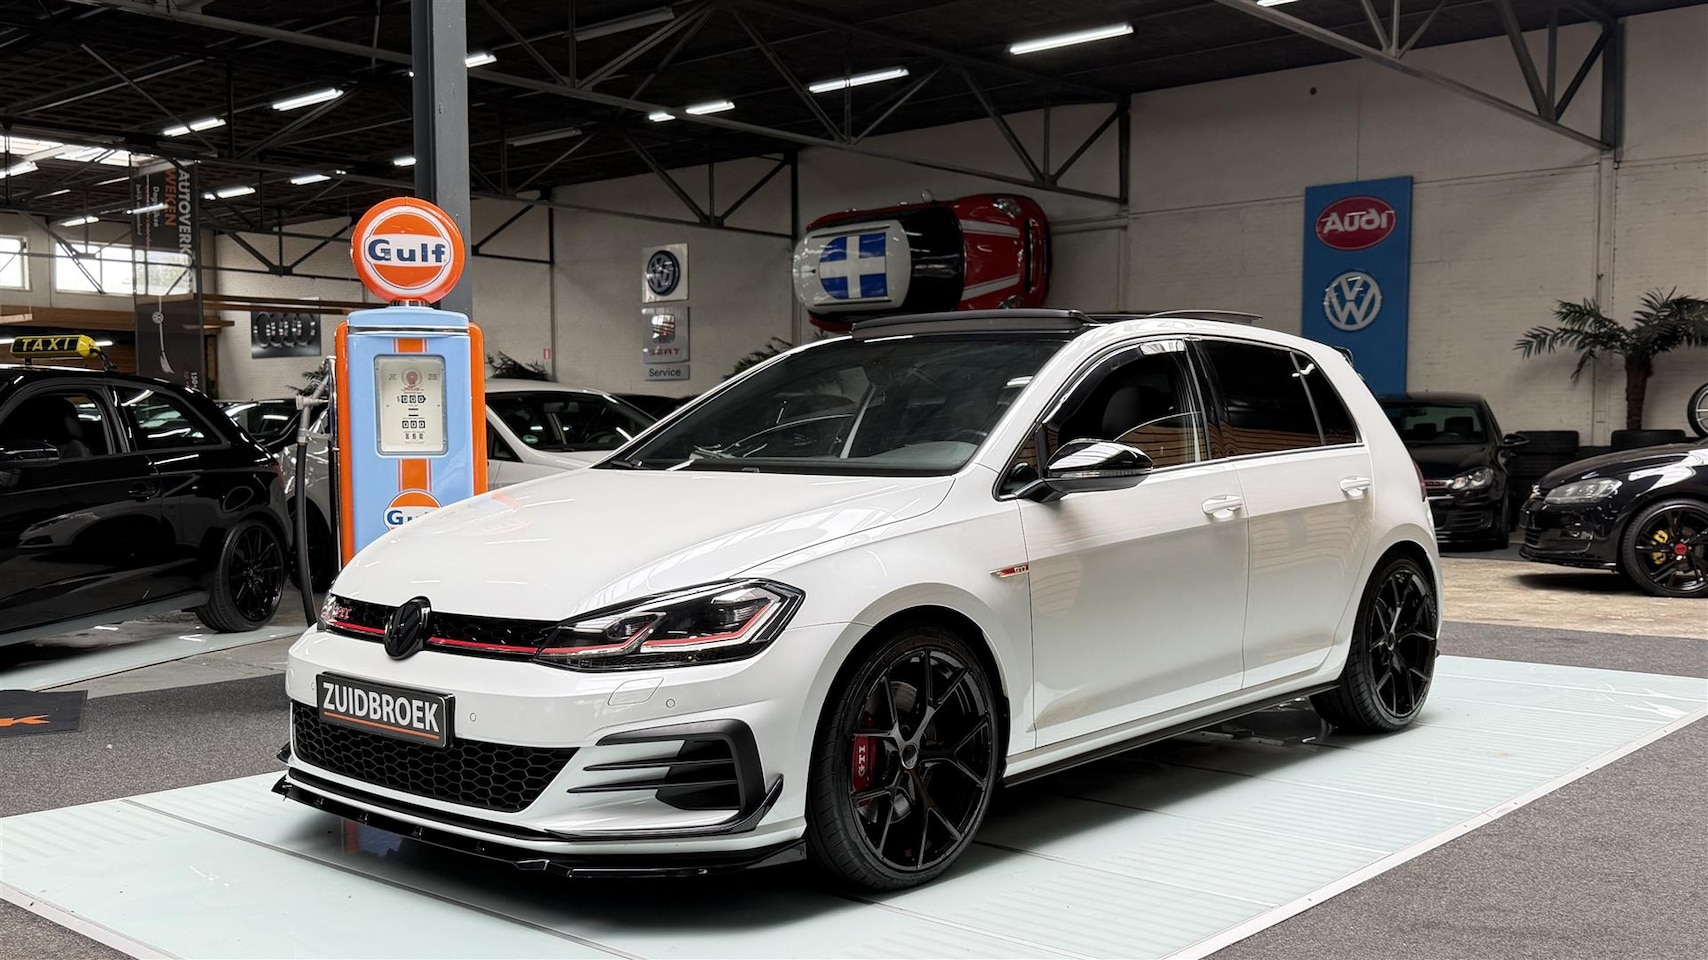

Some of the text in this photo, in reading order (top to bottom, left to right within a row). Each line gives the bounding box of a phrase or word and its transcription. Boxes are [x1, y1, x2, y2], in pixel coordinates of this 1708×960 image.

[178, 169, 193, 289] AUTOVERK
[1322, 207, 1388, 234] Audi
[367, 238, 446, 263] Gulf
[22, 338, 70, 351] TAXI
[648, 367, 682, 377] Service
[322, 682, 439, 732] ZUIDBROEK
[857, 744, 866, 778] GTI
